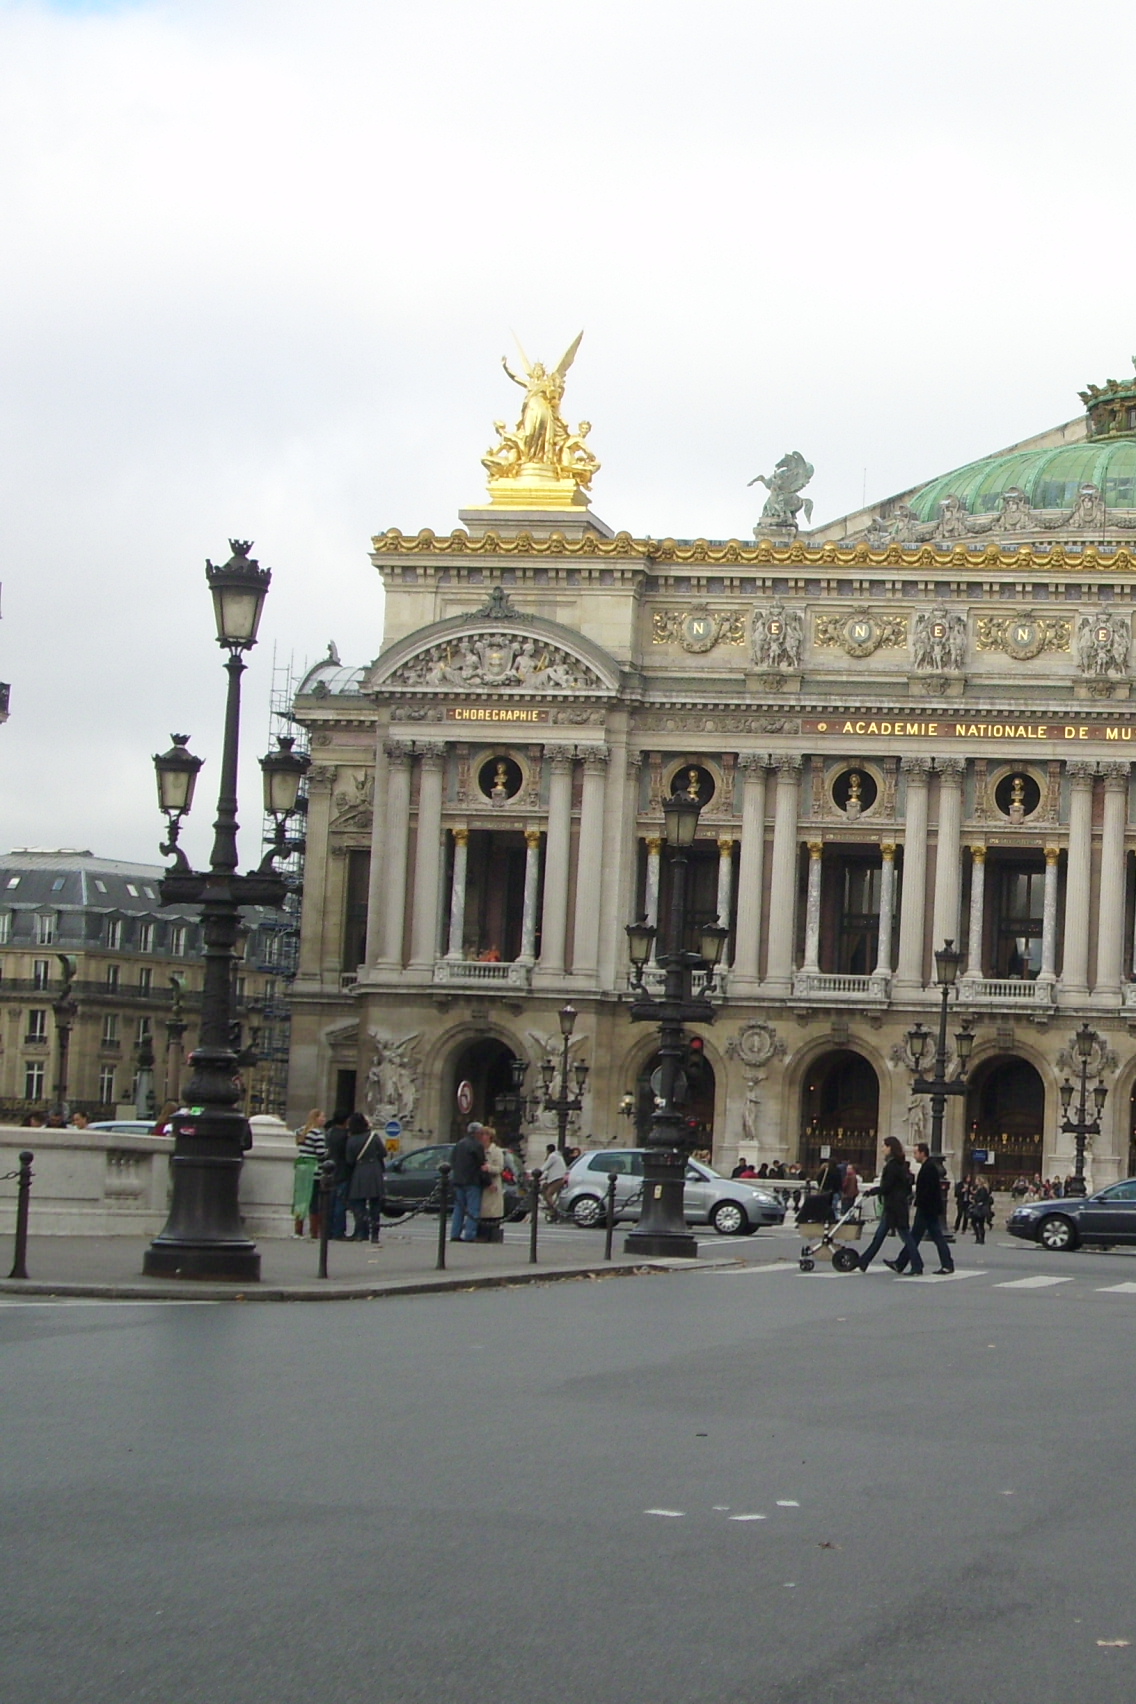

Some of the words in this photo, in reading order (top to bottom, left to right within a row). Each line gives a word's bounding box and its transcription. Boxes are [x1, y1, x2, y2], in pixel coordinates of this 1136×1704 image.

[693, 622, 703, 635] N
[771, 620, 779, 634] E
[855, 625, 866, 637] N
[934, 626, 942, 637] E
[1017, 628, 1028, 641] N
[1098, 629, 1107, 641] E
[455, 709, 539, 721] CHOREGRAPHIE
[842, 721, 938, 736] ACADEMIE
[955, 724, 1047, 738] NATIONALE
[1064, 727, 1089, 739] DE
